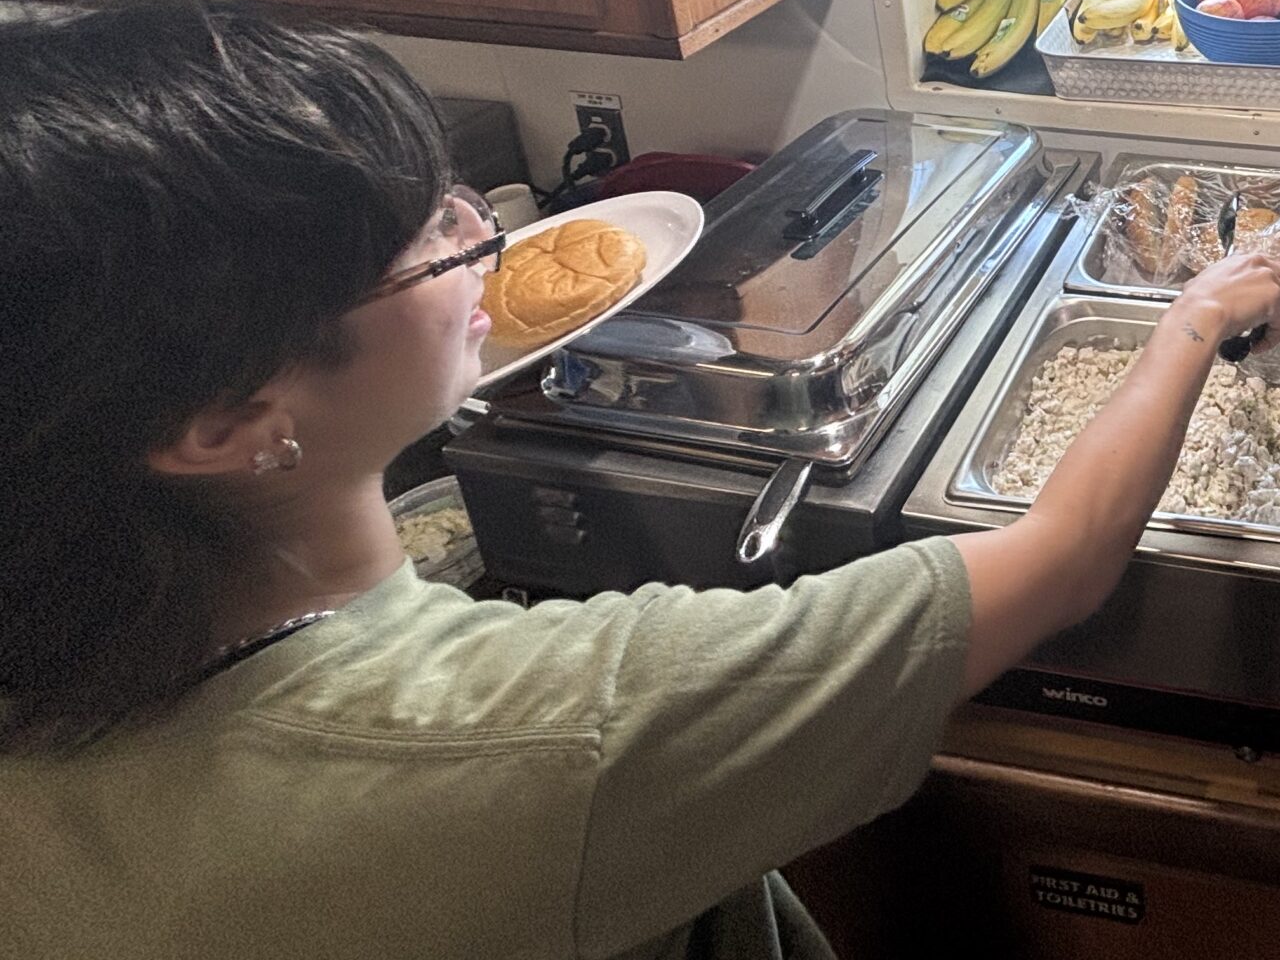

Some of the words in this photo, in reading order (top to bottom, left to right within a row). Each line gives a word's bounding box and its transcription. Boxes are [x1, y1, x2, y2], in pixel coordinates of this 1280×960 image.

[1031, 873, 1080, 892] FIRST
[1086, 884, 1119, 900] AID
[1126, 891, 1140, 905] &
[1036, 890, 1138, 919] TOILETRIES
